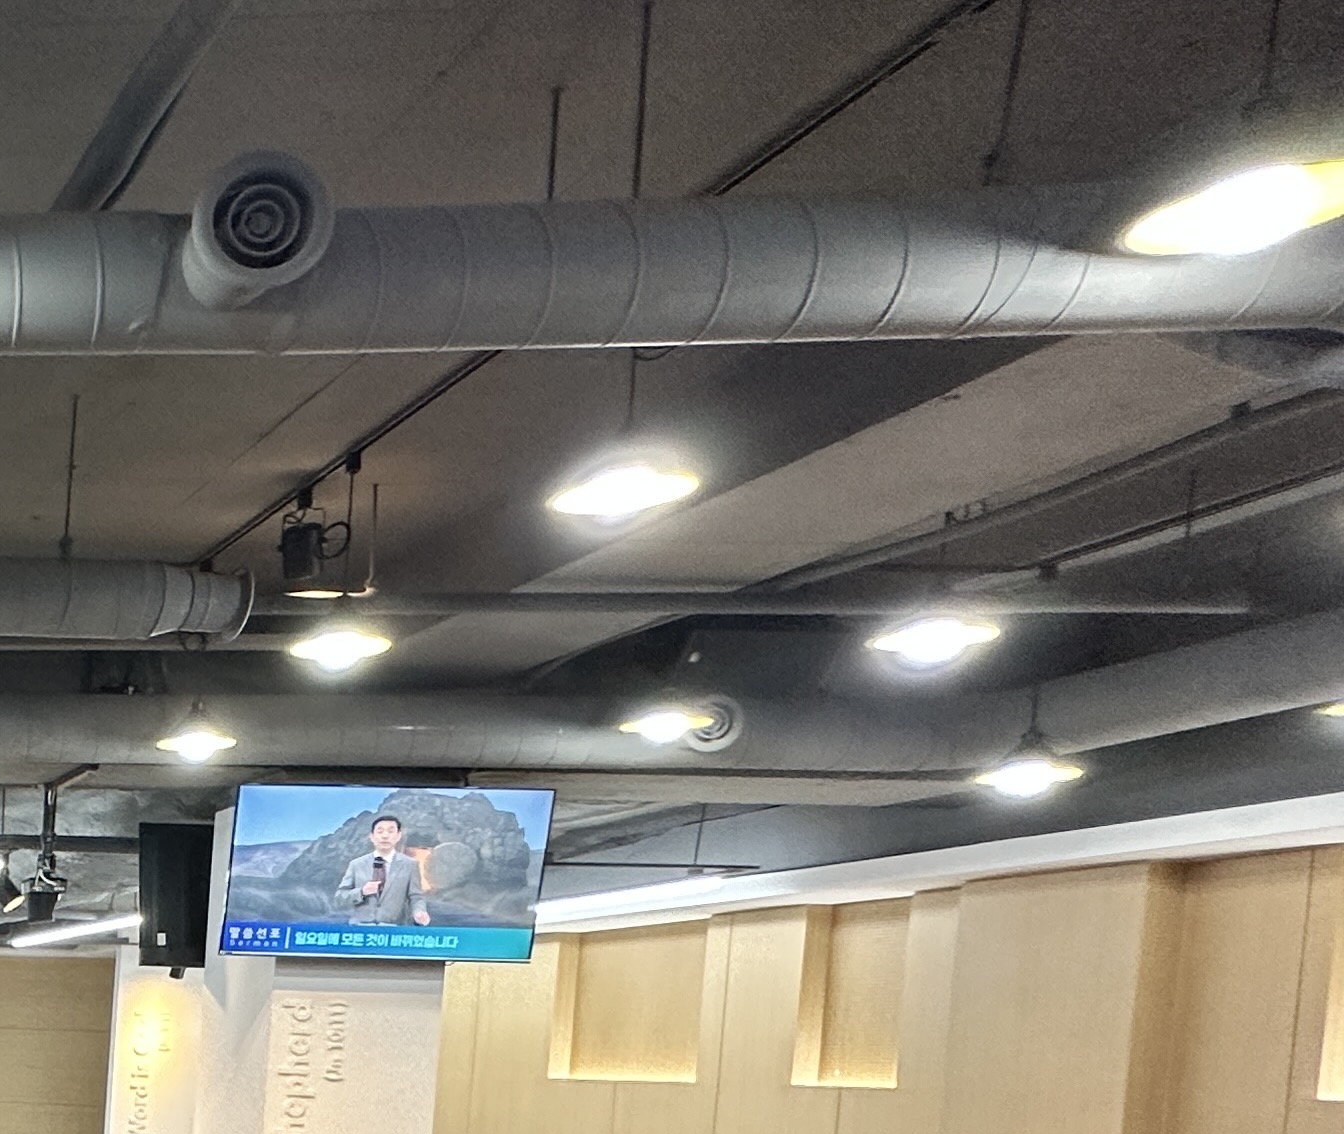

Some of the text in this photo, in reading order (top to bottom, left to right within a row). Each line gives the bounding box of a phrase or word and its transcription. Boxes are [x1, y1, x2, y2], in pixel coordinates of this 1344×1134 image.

[295, 931, 459, 949] 일요일에 모든 것이 바뀌었습니다
